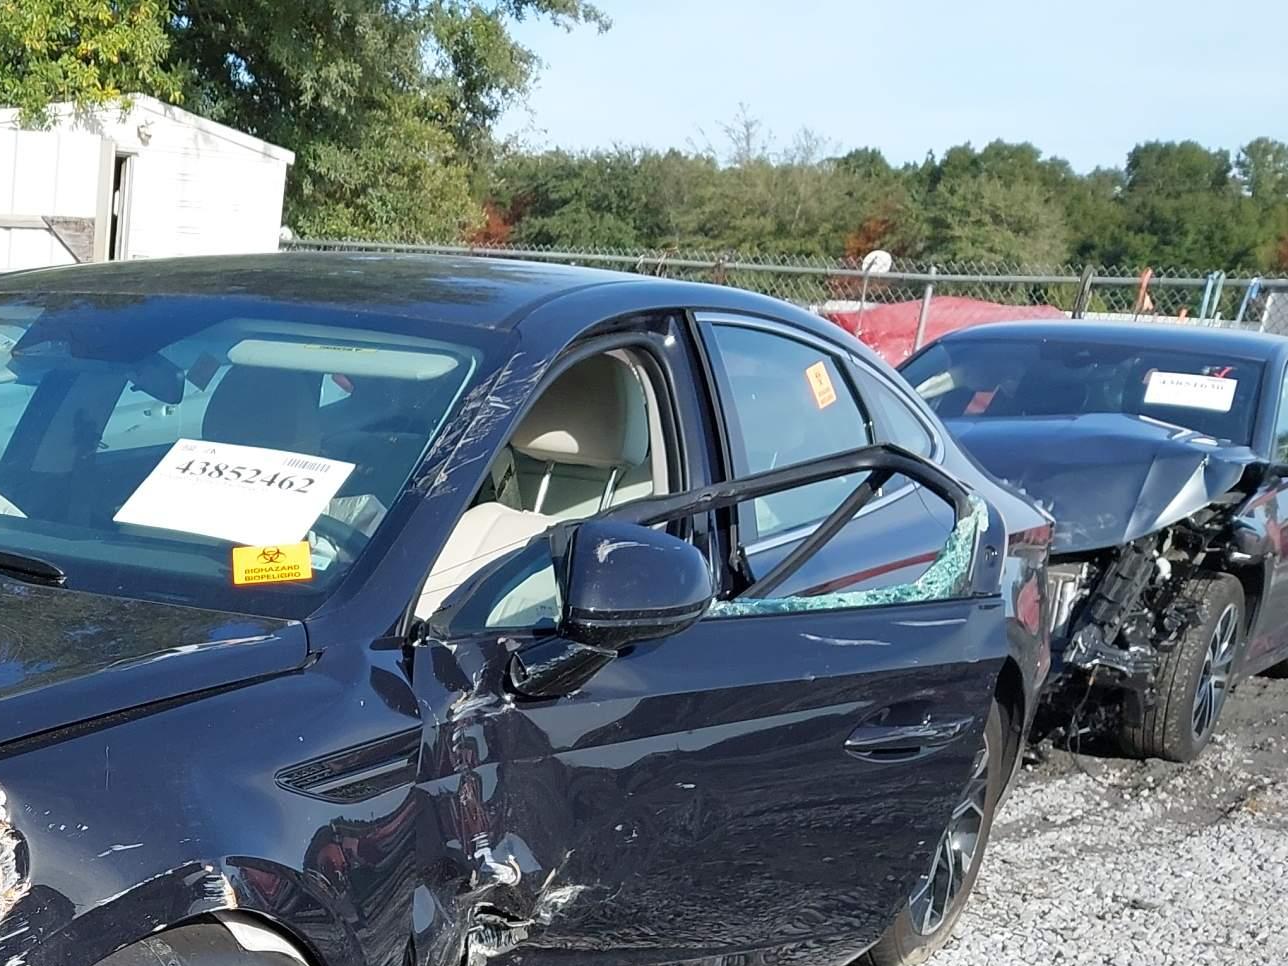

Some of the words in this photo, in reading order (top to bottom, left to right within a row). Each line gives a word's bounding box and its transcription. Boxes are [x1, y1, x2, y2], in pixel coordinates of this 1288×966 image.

[175, 458, 316, 494] 43852462
[244, 564, 300, 575] BIOHAZARD
[244, 571, 301, 582] BIOPELIGRO
